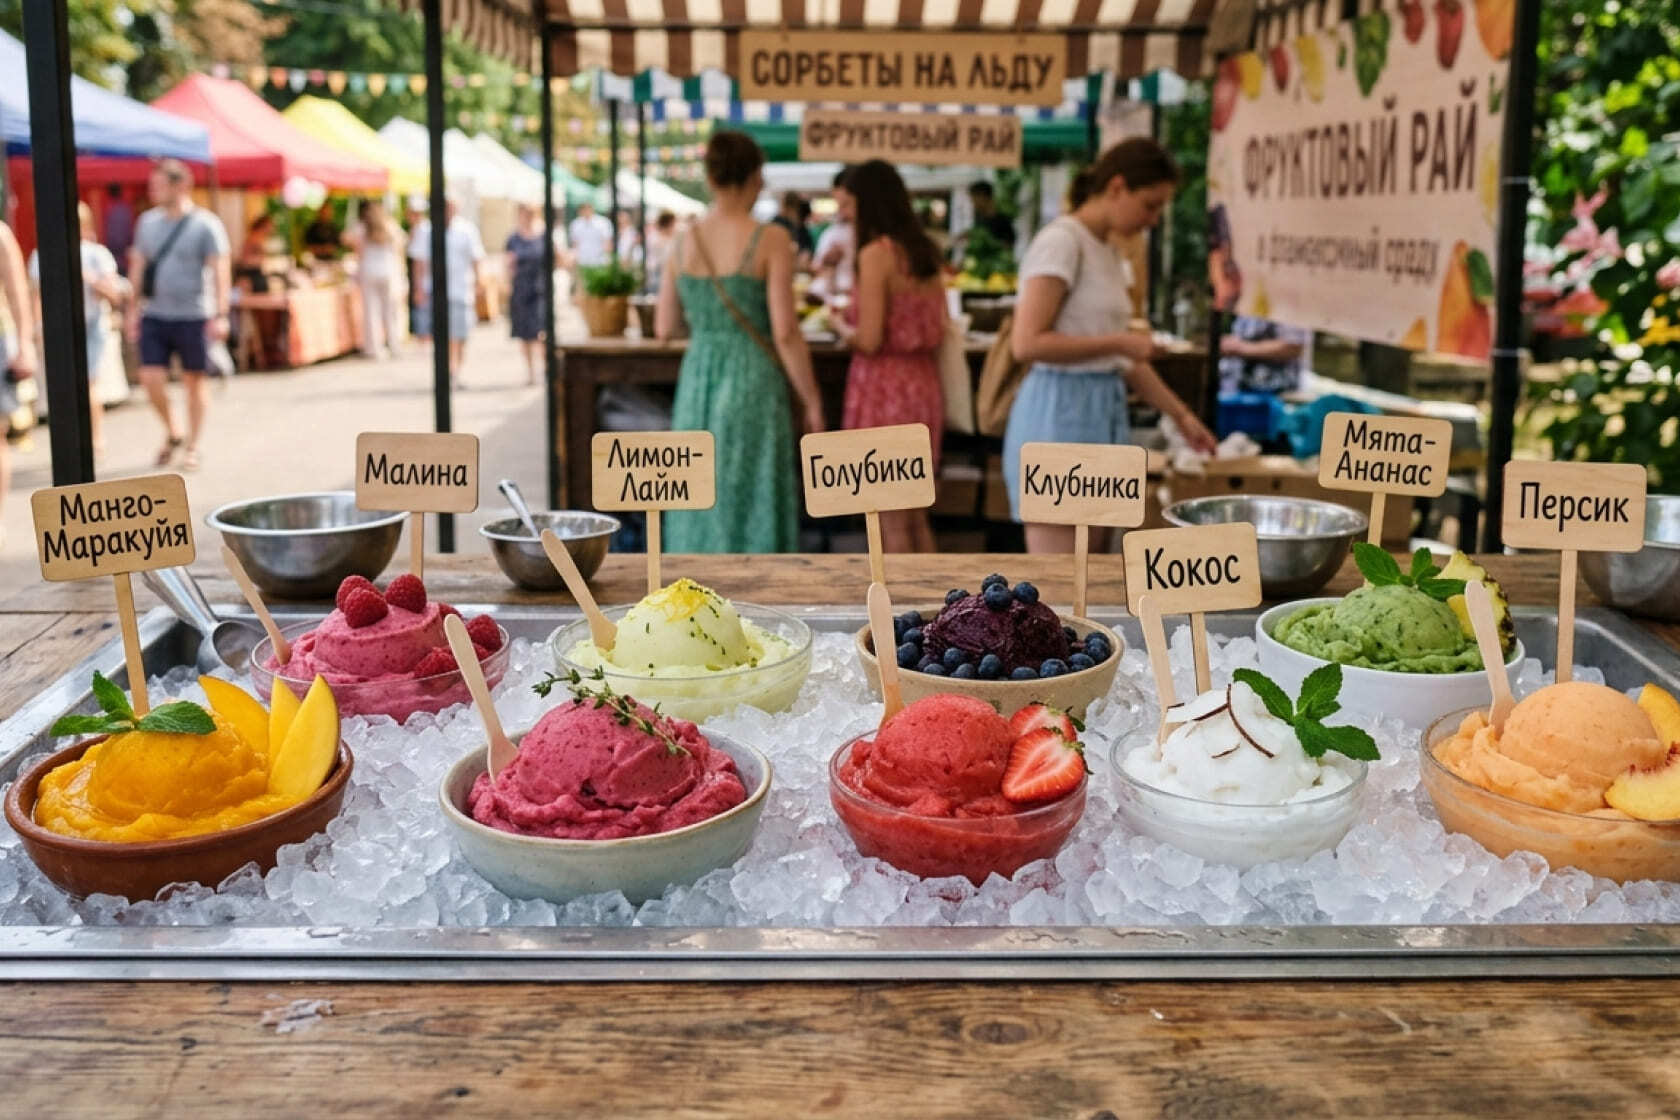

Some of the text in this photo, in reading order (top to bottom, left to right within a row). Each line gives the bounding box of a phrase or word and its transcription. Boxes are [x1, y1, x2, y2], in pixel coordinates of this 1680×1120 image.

[752, 50, 1054, 93] СОРБЕТЫ НА ЛЬДУ
[806, 120, 1016, 154] ФРУКТОВЫЙ РАЙ
[1244, 80, 1478, 200] ФРУКТОВЫЙ РАЙ
[607, 438, 703, 469] Лимон-
[1343, 419, 1437, 455] Мята-
[364, 453, 468, 487] Малина
[620, 471, 689, 502] Лайм
[810, 449, 926, 495] Голубика
[1024, 463, 1140, 505] Клубника
[1334, 450, 1433, 486] Ананас
[60, 493, 167, 526] Манго-
[1520, 481, 1630, 532] Персик
[43, 517, 189, 567] Маракуйя
[1144, 547, 1241, 590] Кокос
